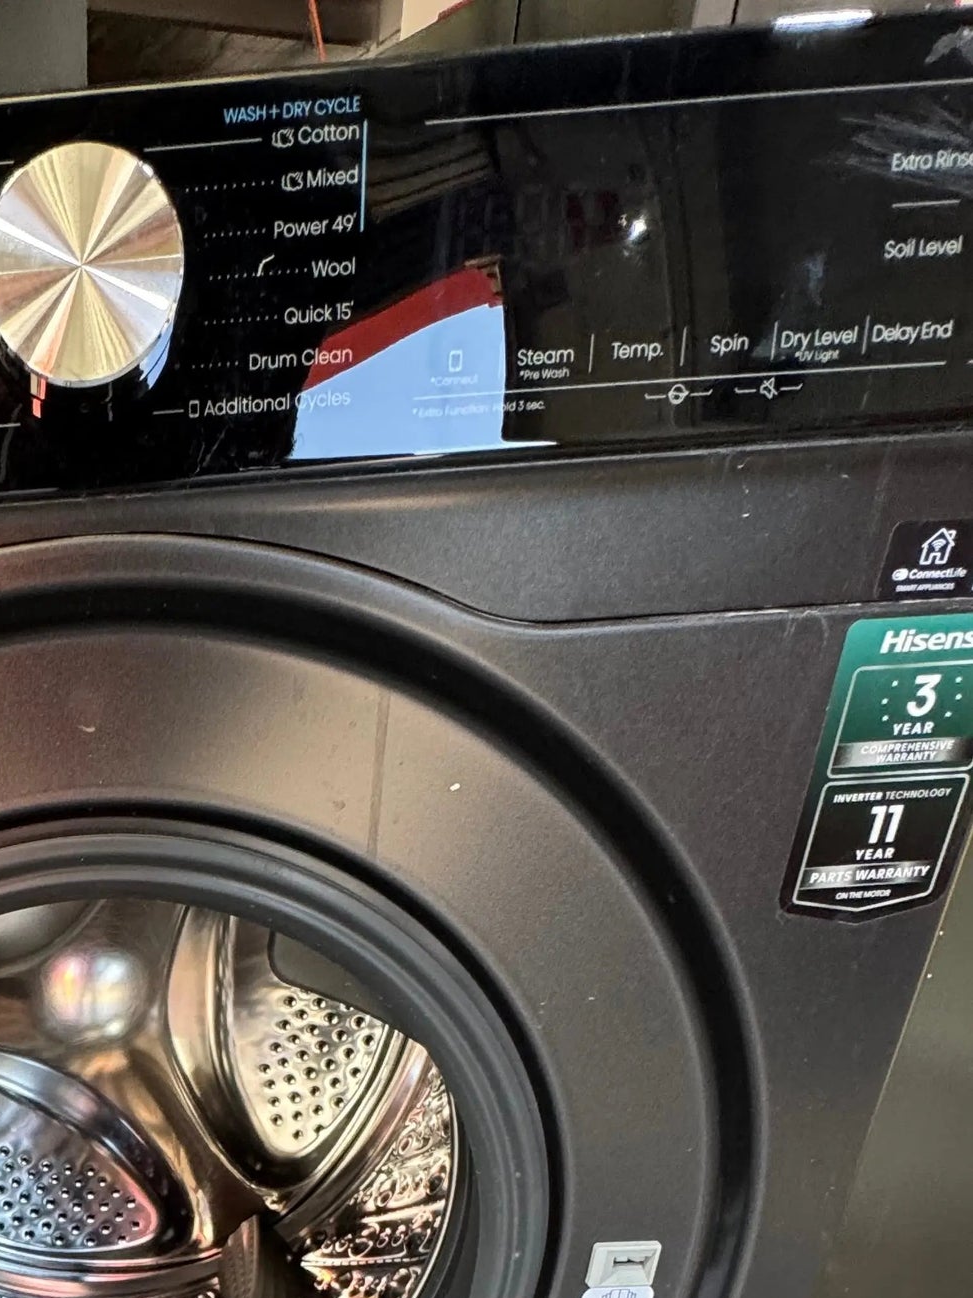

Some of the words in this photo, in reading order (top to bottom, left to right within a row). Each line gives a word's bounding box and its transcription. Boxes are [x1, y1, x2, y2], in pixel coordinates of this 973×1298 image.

[223, 104, 267, 124] WASH
[282, 101, 313, 119] DRY
[314, 95, 362, 116] CYCLE
[298, 124, 360, 145] Cotton
[891, 152, 933, 172] Extra
[306, 164, 360, 188] Mixed
[273, 219, 329, 239] Power
[884, 238, 916, 259] Soil
[918, 234, 964, 257] Level
[311, 256, 356, 278] Wool
[284, 304, 332, 325] Quick
[781, 330, 811, 352] Dry
[814, 325, 859, 346] Level
[872, 323, 919, 344] Delay
[919, 319, 955, 340] End
[611, 341, 664, 361] Temp.
[710, 334, 749, 356] Spin
[249, 353, 297, 371] Drum
[301, 347, 353, 366] Clean
[517, 348, 574, 367] Steam
[541, 368, 570, 380] Wash
[204, 393, 290, 416] Additional
[295, 390, 351, 413] Cycles
[909, 567, 967, 580] ConnectLife
[906, 673, 942, 717] 3
[892, 721, 934, 735] YEAR
[860, 740, 955, 755] COMPREHENSIVE
[875, 750, 938, 764] WARRANTY
[833, 791, 883, 803] INVERTER
[885, 787, 953, 801] TECHNOLOGY
[867, 804, 904, 844] 11
[855, 847, 895, 860] YEAR
[808, 870, 853, 884] PARTS
[855, 865, 931, 881] WARRANTY
